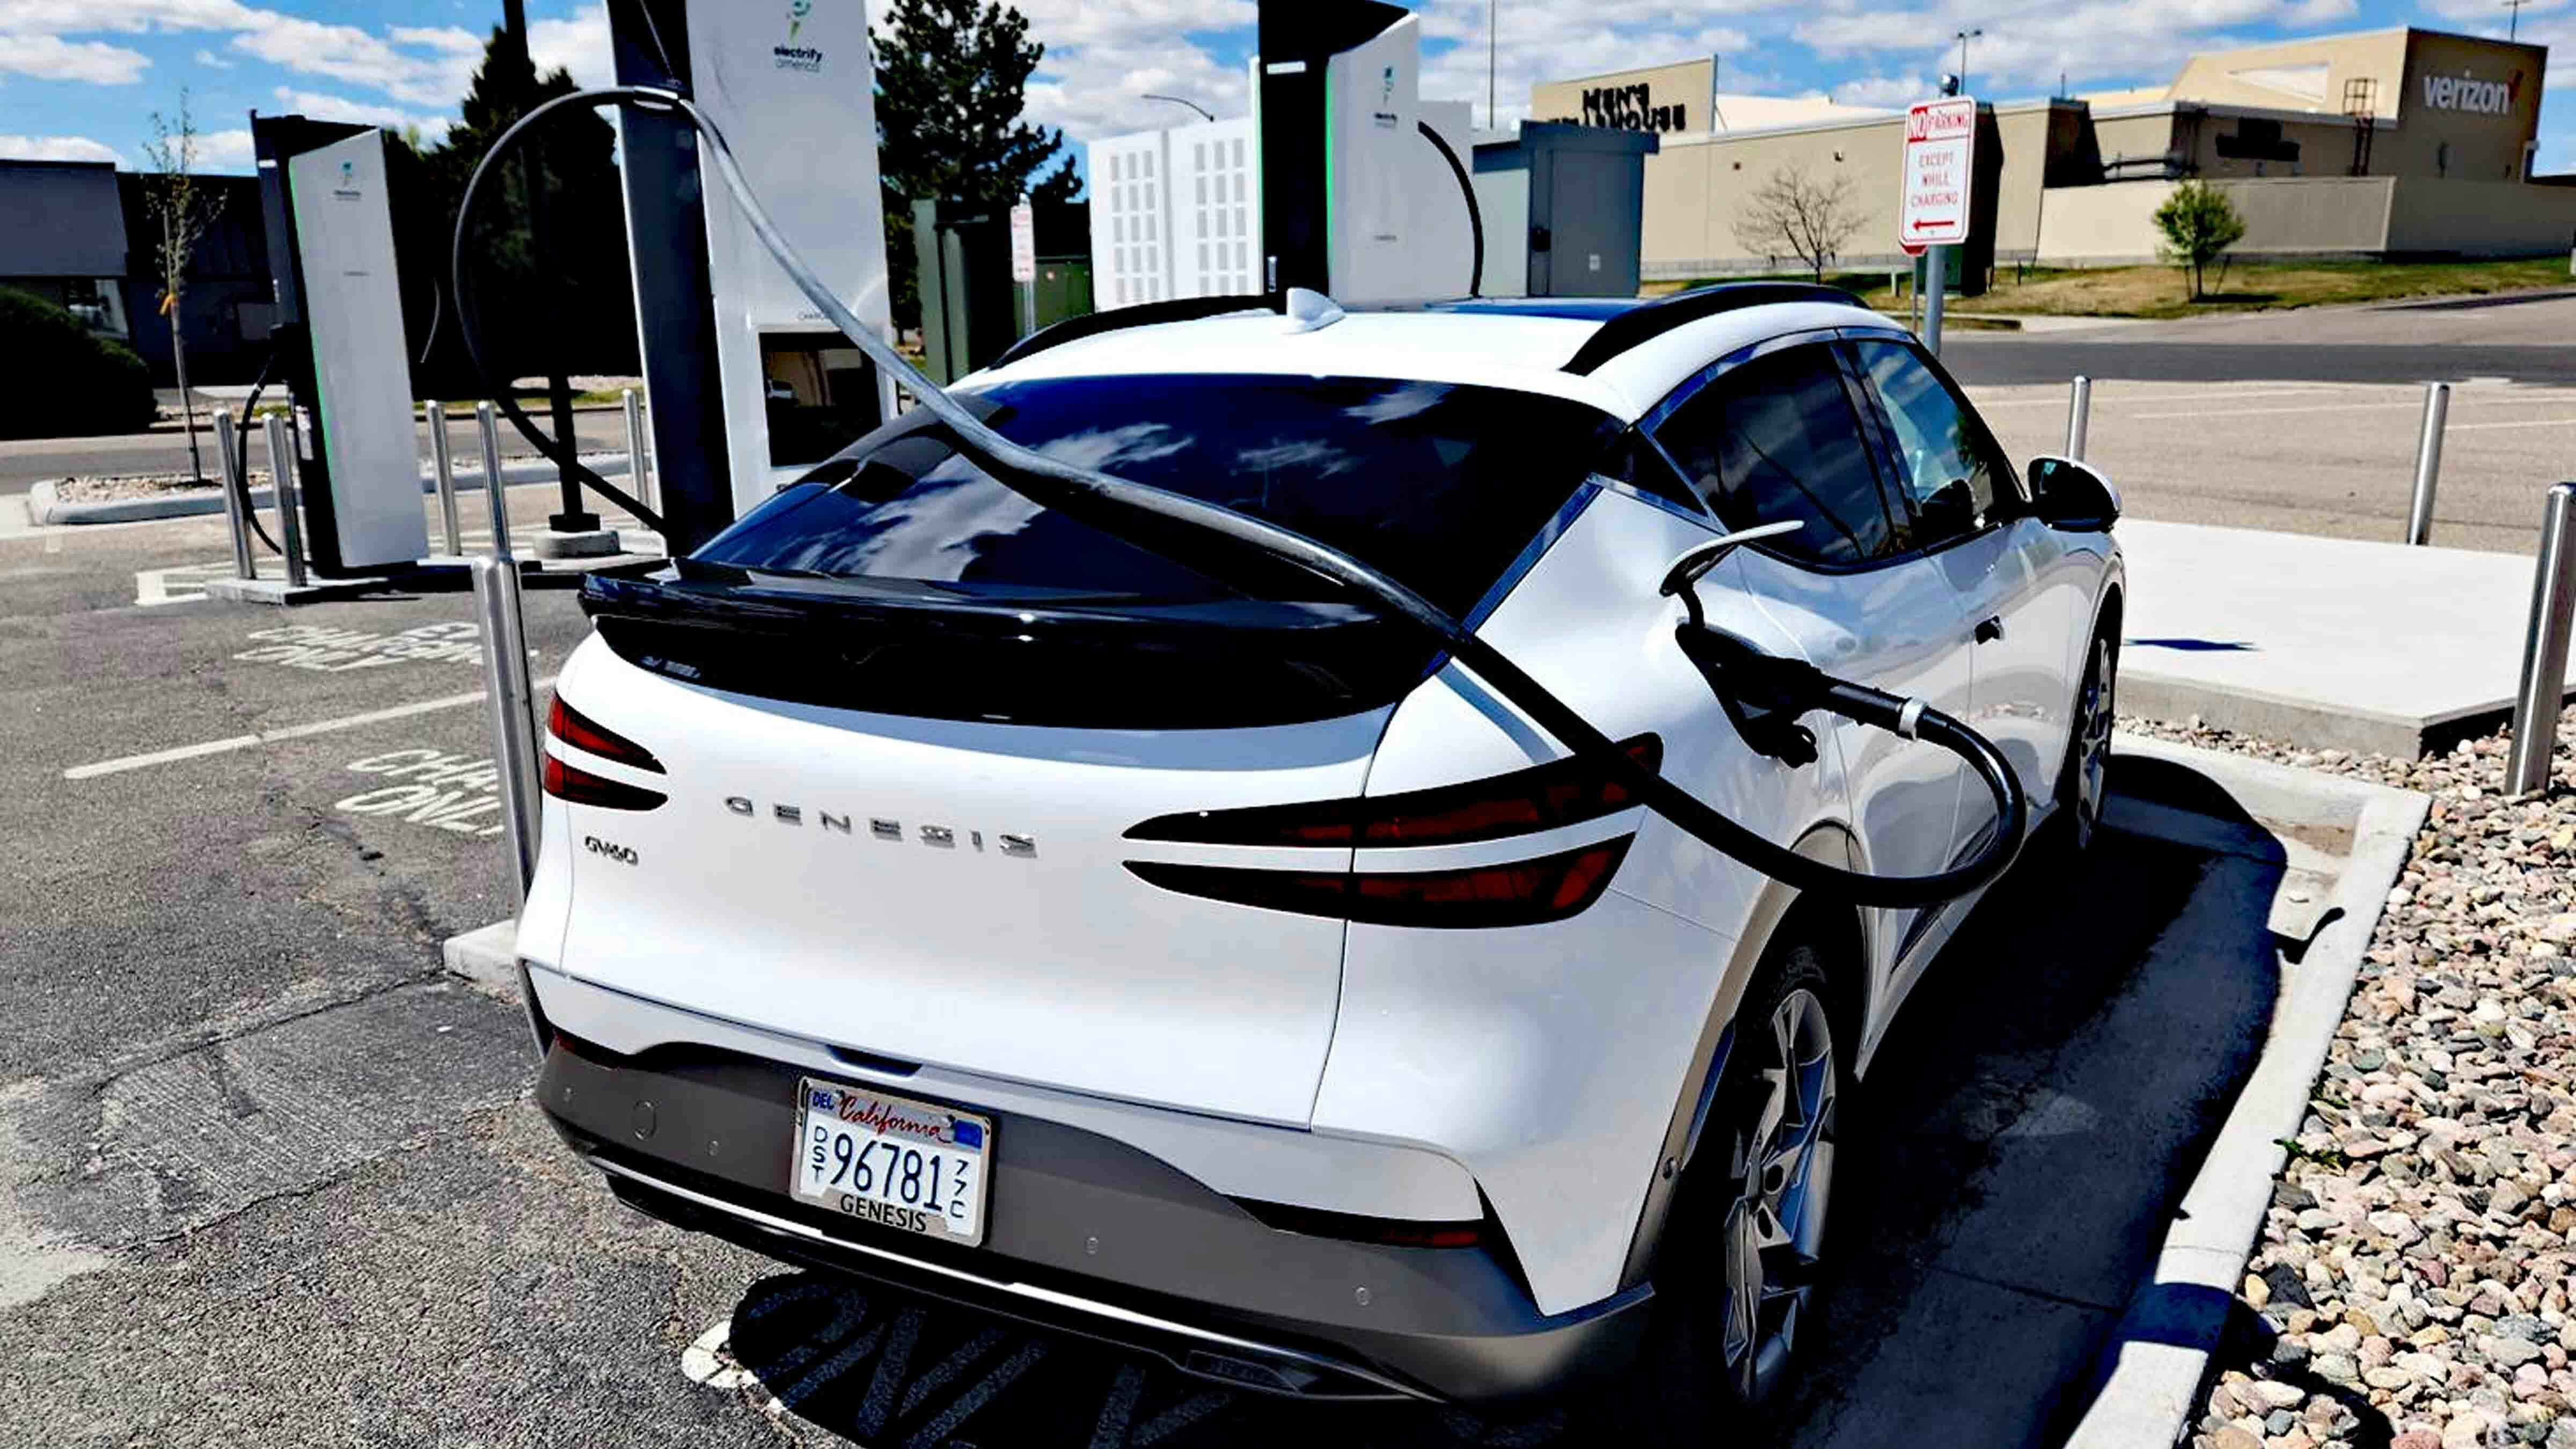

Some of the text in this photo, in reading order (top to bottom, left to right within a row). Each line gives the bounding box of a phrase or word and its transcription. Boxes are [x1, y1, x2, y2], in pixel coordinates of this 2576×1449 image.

[2424, 70, 2508, 114] verizon
[1909, 110, 1969, 137] NO PARKING
[1911, 192, 1959, 207] CHARGING
[1922, 172, 1950, 187] WHILE
[725, 795, 1039, 859] GENESIS
[838, 1096, 953, 1144] California
[830, 1132, 942, 1212] 96781
[840, 1194, 927, 1233] GENESIS
